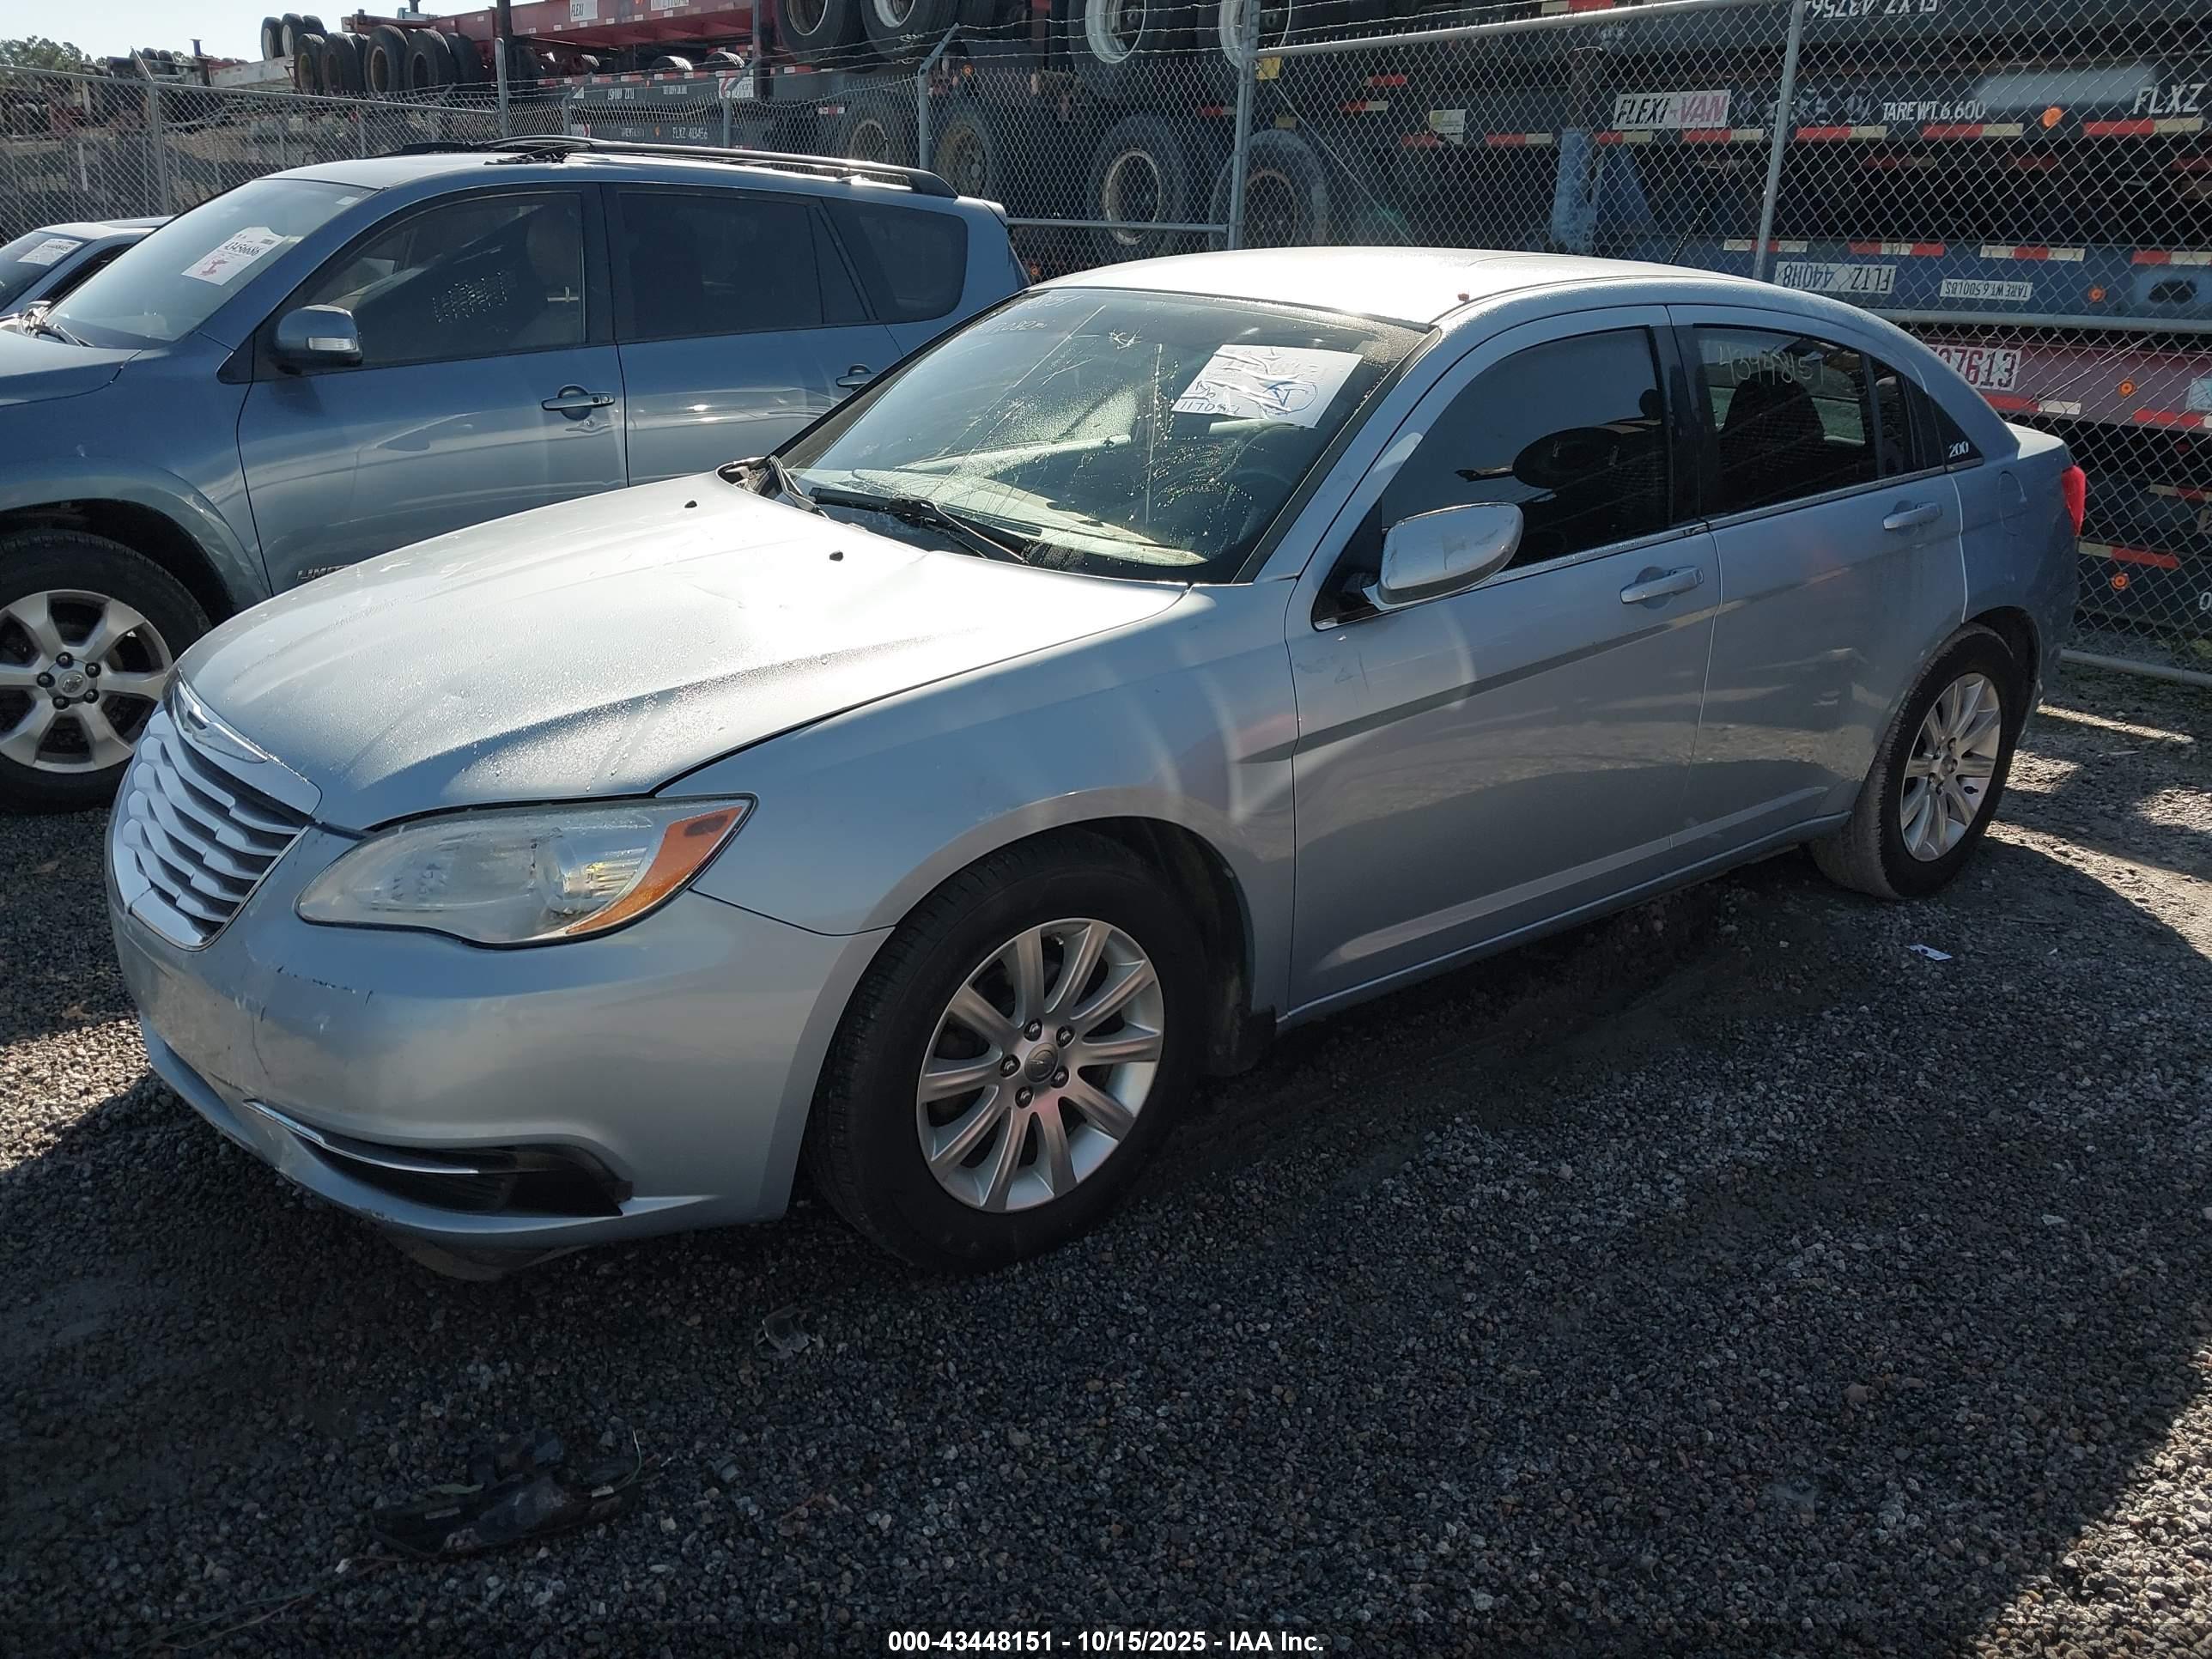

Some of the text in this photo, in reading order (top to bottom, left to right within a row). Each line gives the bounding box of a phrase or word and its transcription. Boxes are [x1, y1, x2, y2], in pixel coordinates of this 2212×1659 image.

[2132, 83, 2206, 114] FLXZ
[1883, 101, 1917, 120] TARE
[1850, 267, 1892, 291] FLTZ
[1949, 441, 1969, 458] 200
